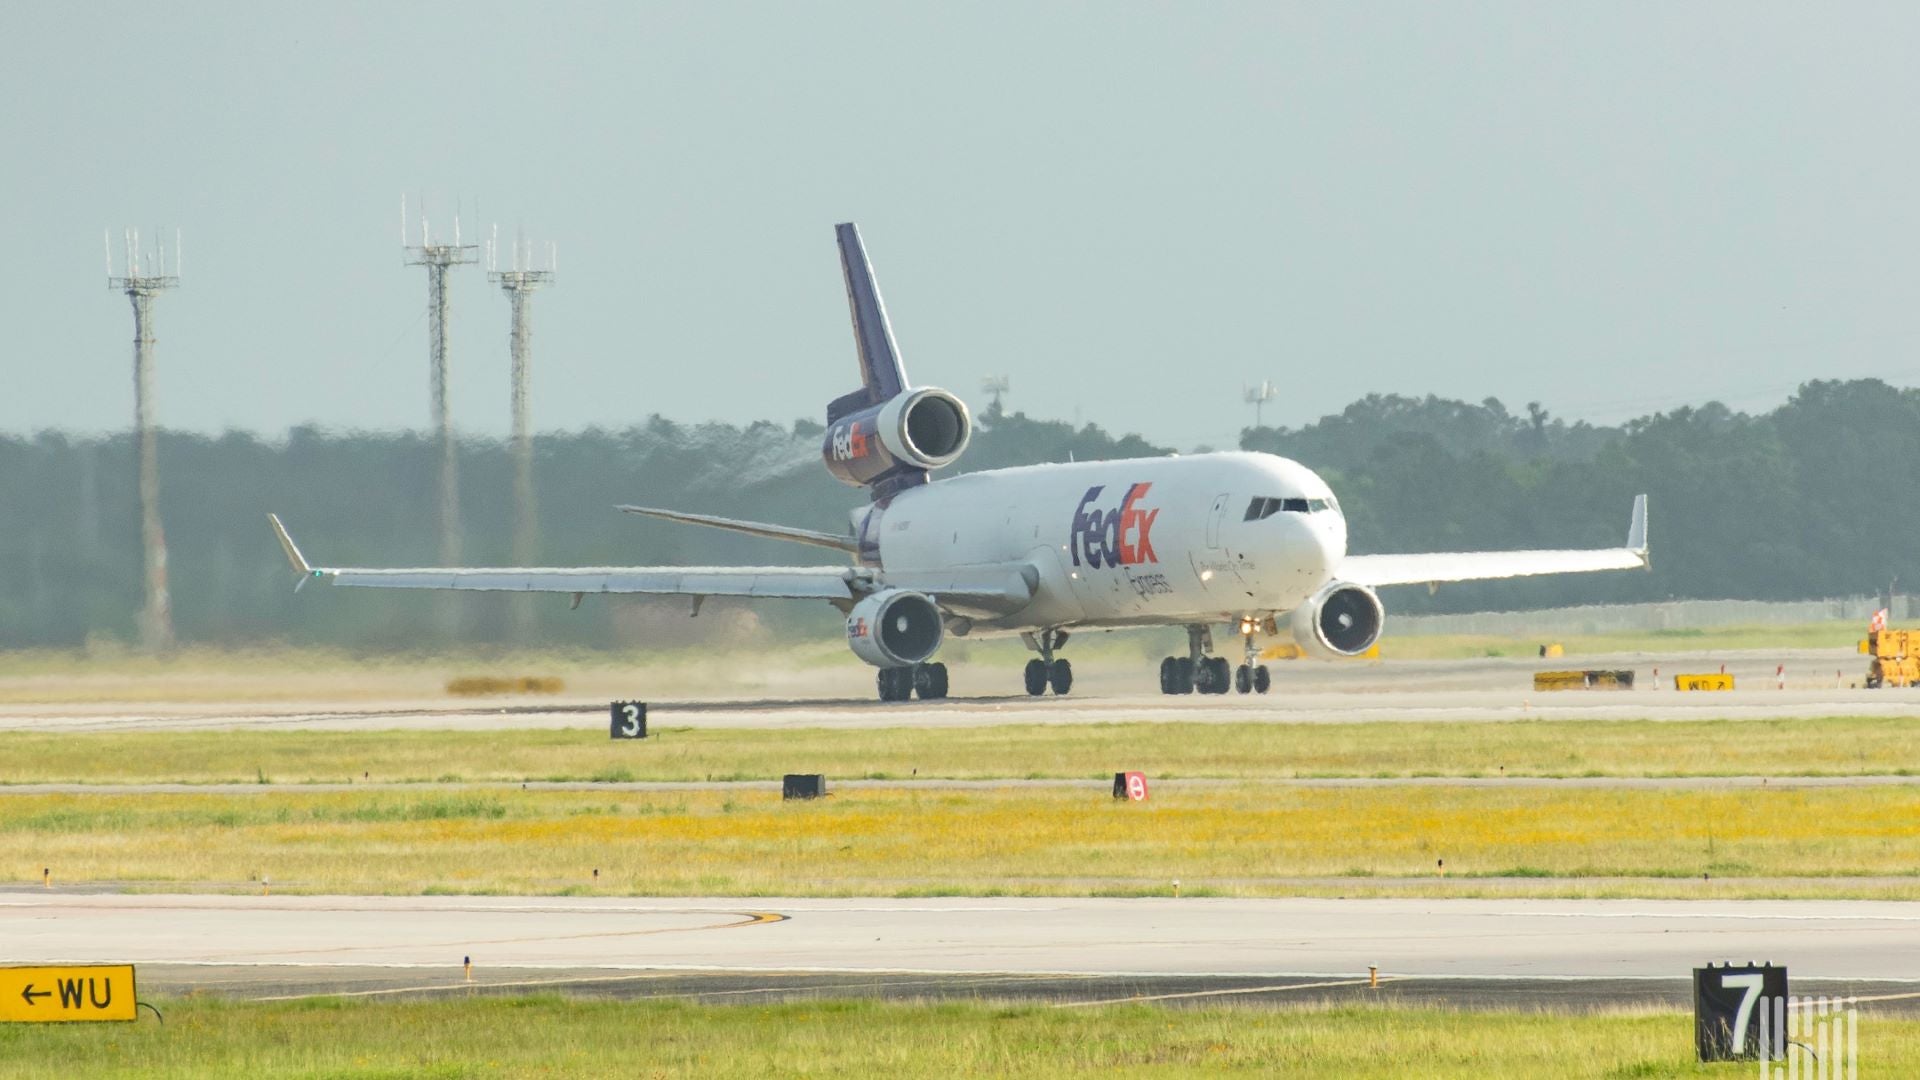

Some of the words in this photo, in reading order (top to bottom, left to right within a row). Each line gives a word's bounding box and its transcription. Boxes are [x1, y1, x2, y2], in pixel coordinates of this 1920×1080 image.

[833, 422, 869, 461] FedEx
[1071, 482, 1159, 569] FedEx
[622, 705, 640, 736] 3
[57, 978, 111, 1008] WU
[1721, 974, 1763, 1054] 7
